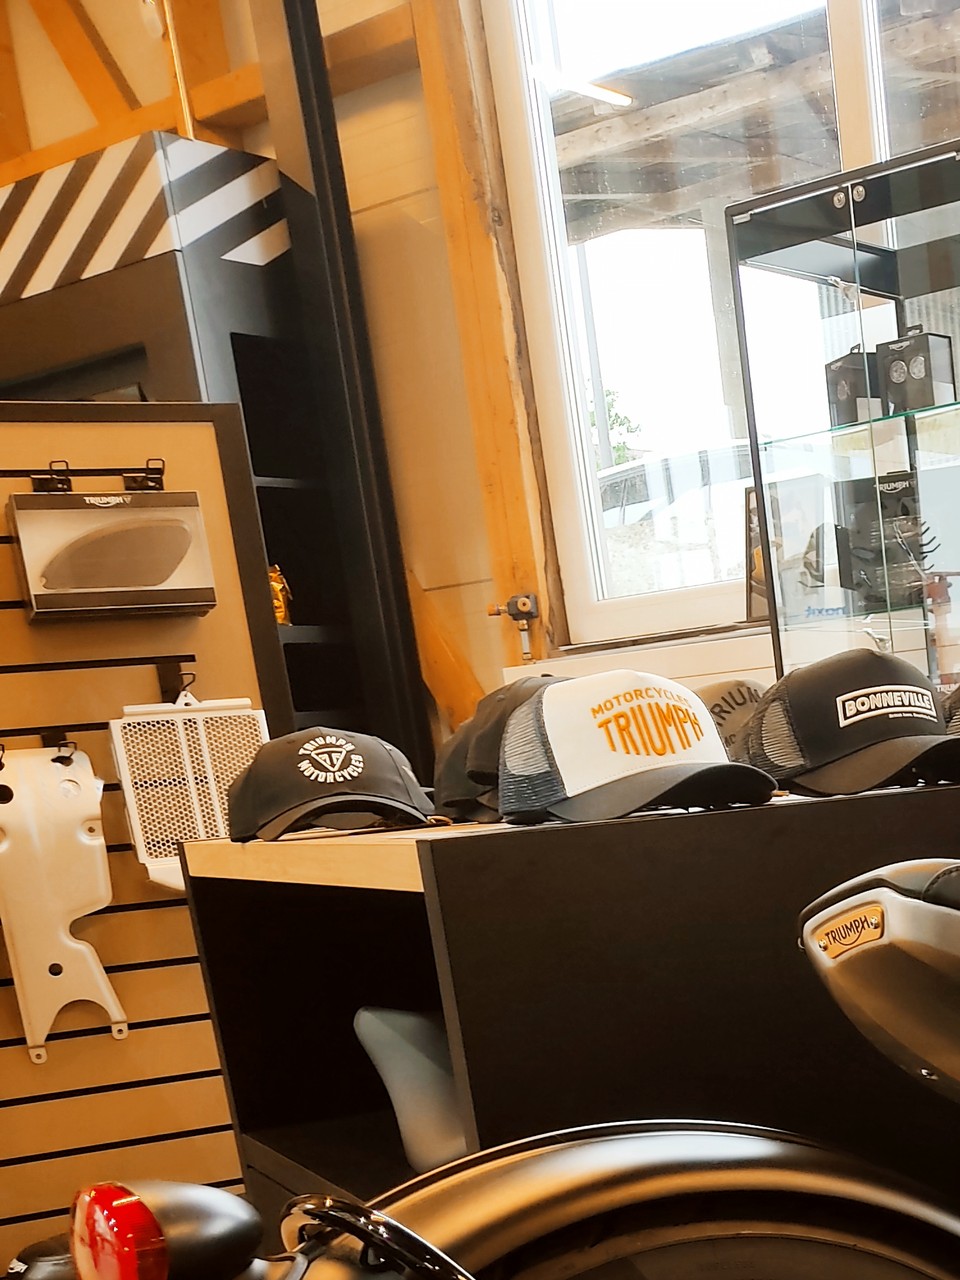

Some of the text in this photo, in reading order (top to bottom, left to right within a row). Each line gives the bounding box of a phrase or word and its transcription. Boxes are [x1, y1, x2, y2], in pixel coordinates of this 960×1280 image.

[83, 496, 124, 507] TRIUMPH
[590, 686, 693, 719] MOTORCYCLES
[710, 686, 762, 728] RIUM
[845, 691, 932, 717] BONNEVILLE
[597, 701, 704, 756] TRIUMPH
[298, 735, 356, 755] TRIUMPH
[297, 754, 364, 783] MOTORCYCLES
[825, 914, 871, 946] TRIUMPH
